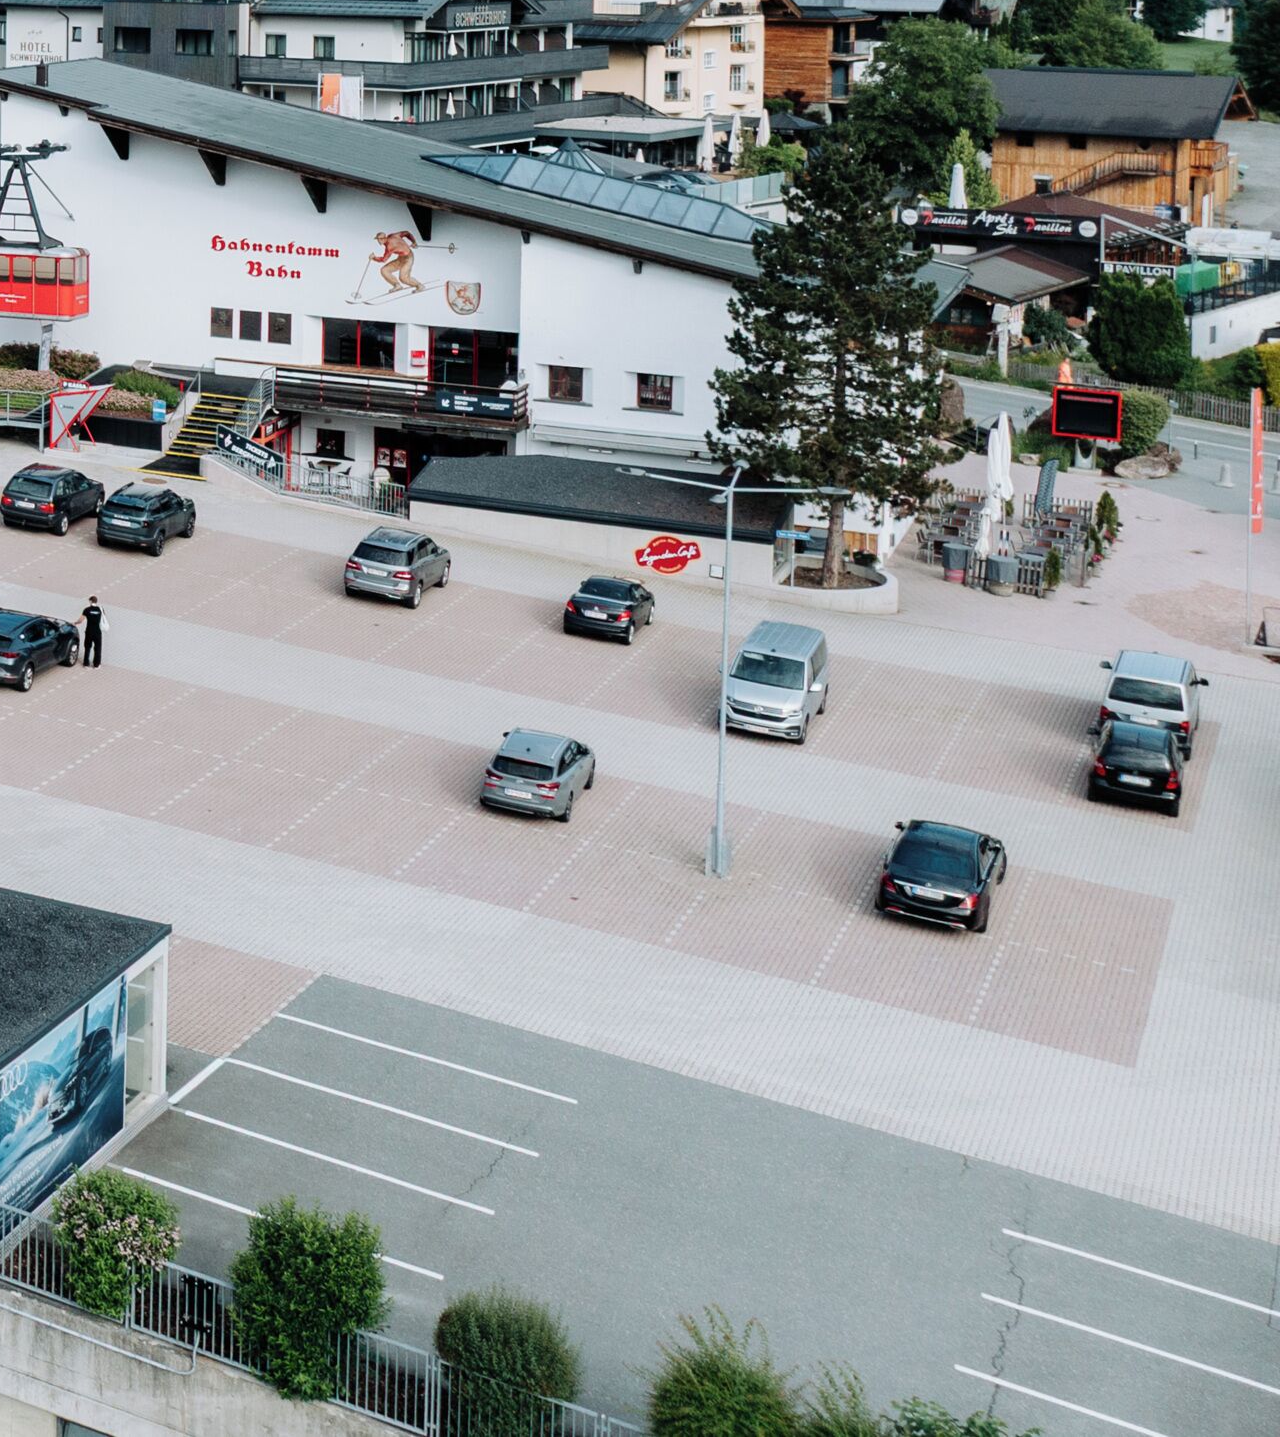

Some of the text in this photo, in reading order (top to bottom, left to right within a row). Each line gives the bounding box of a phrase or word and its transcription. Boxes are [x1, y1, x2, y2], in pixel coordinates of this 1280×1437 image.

[455, 10, 507, 27] SCHWEIZERHOF
[20, 42, 53, 53] HOTEL
[992, 223, 1018, 236] Ski
[211, 235, 340, 258] Hahnenkamm
[245, 260, 302, 280] Bahn
[1116, 263, 1171, 276] PAVILLON
[245, 442, 269, 459] TICKETS
